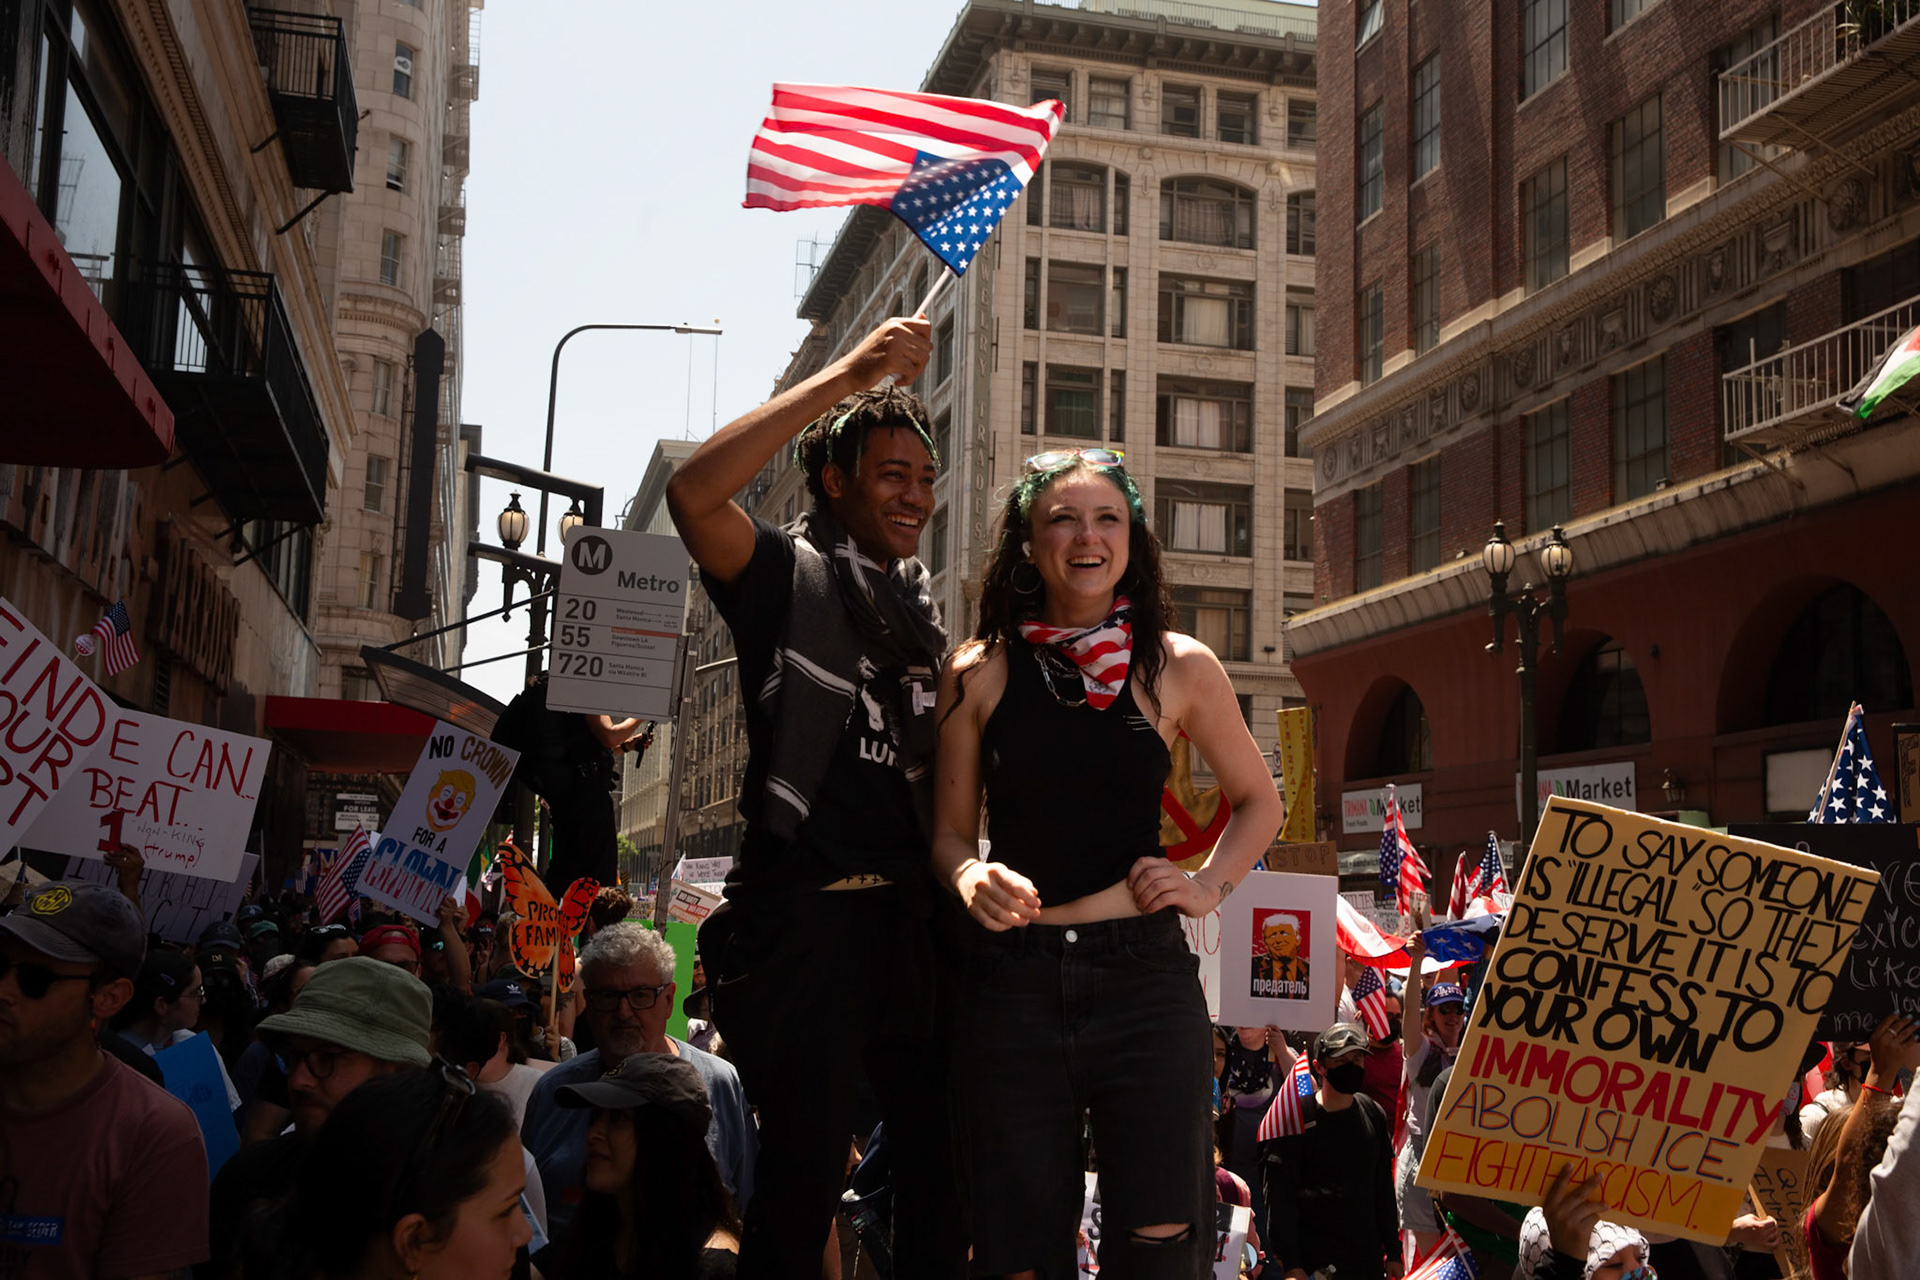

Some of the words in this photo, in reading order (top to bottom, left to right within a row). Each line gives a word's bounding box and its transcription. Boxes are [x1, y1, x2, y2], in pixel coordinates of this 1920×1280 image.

[617, 570, 680, 594] Metro
[565, 598, 597, 621] 20
[616, 608, 644, 616] Westwood
[632, 616, 652, 624] Monica
[560, 624, 591, 648] 55
[611, 634, 640, 642] Downtown
[559, 652, 604, 678] 720
[608, 662, 624, 670] Santa
[625, 663, 645, 672] Monica
[429, 735, 455, 759] NO
[460, 736, 514, 790] CROWN
[1565, 776, 1633, 801] Market
[343, 804, 360, 812] FOR
[1376, 795, 1421, 818] Mket
[412, 826, 436, 848] FOR
[435, 837, 448, 854] A
[1274, 845, 1331, 868] STOP
[1550, 806, 1613, 859] TO
[1622, 830, 1706, 876] SAY
[1696, 843, 1879, 926] SOMEONE
[1522, 854, 1562, 901] IS
[1688, 888, 1754, 941] SO
[1763, 904, 1860, 971] THEY
[1504, 902, 1688, 973] DESERVE
[1686, 937, 1738, 984] IT
[1734, 948, 1780, 998] IS
[1787, 961, 1838, 1015] TO
[1252, 977, 1308, 997] предатель
[1495, 947, 1707, 1027] CONFESS
[1714, 990, 1784, 1052] TO
[1477, 982, 1587, 1045] YOUR
[1592, 1004, 1721, 1074] OWN
[1469, 1034, 1784, 1146] IMMORALITY
[1445, 1082, 1641, 1163] ABOLISH
[1649, 1125, 1741, 1183] ICE.
[1433, 1131, 1550, 1193] FIGHT
